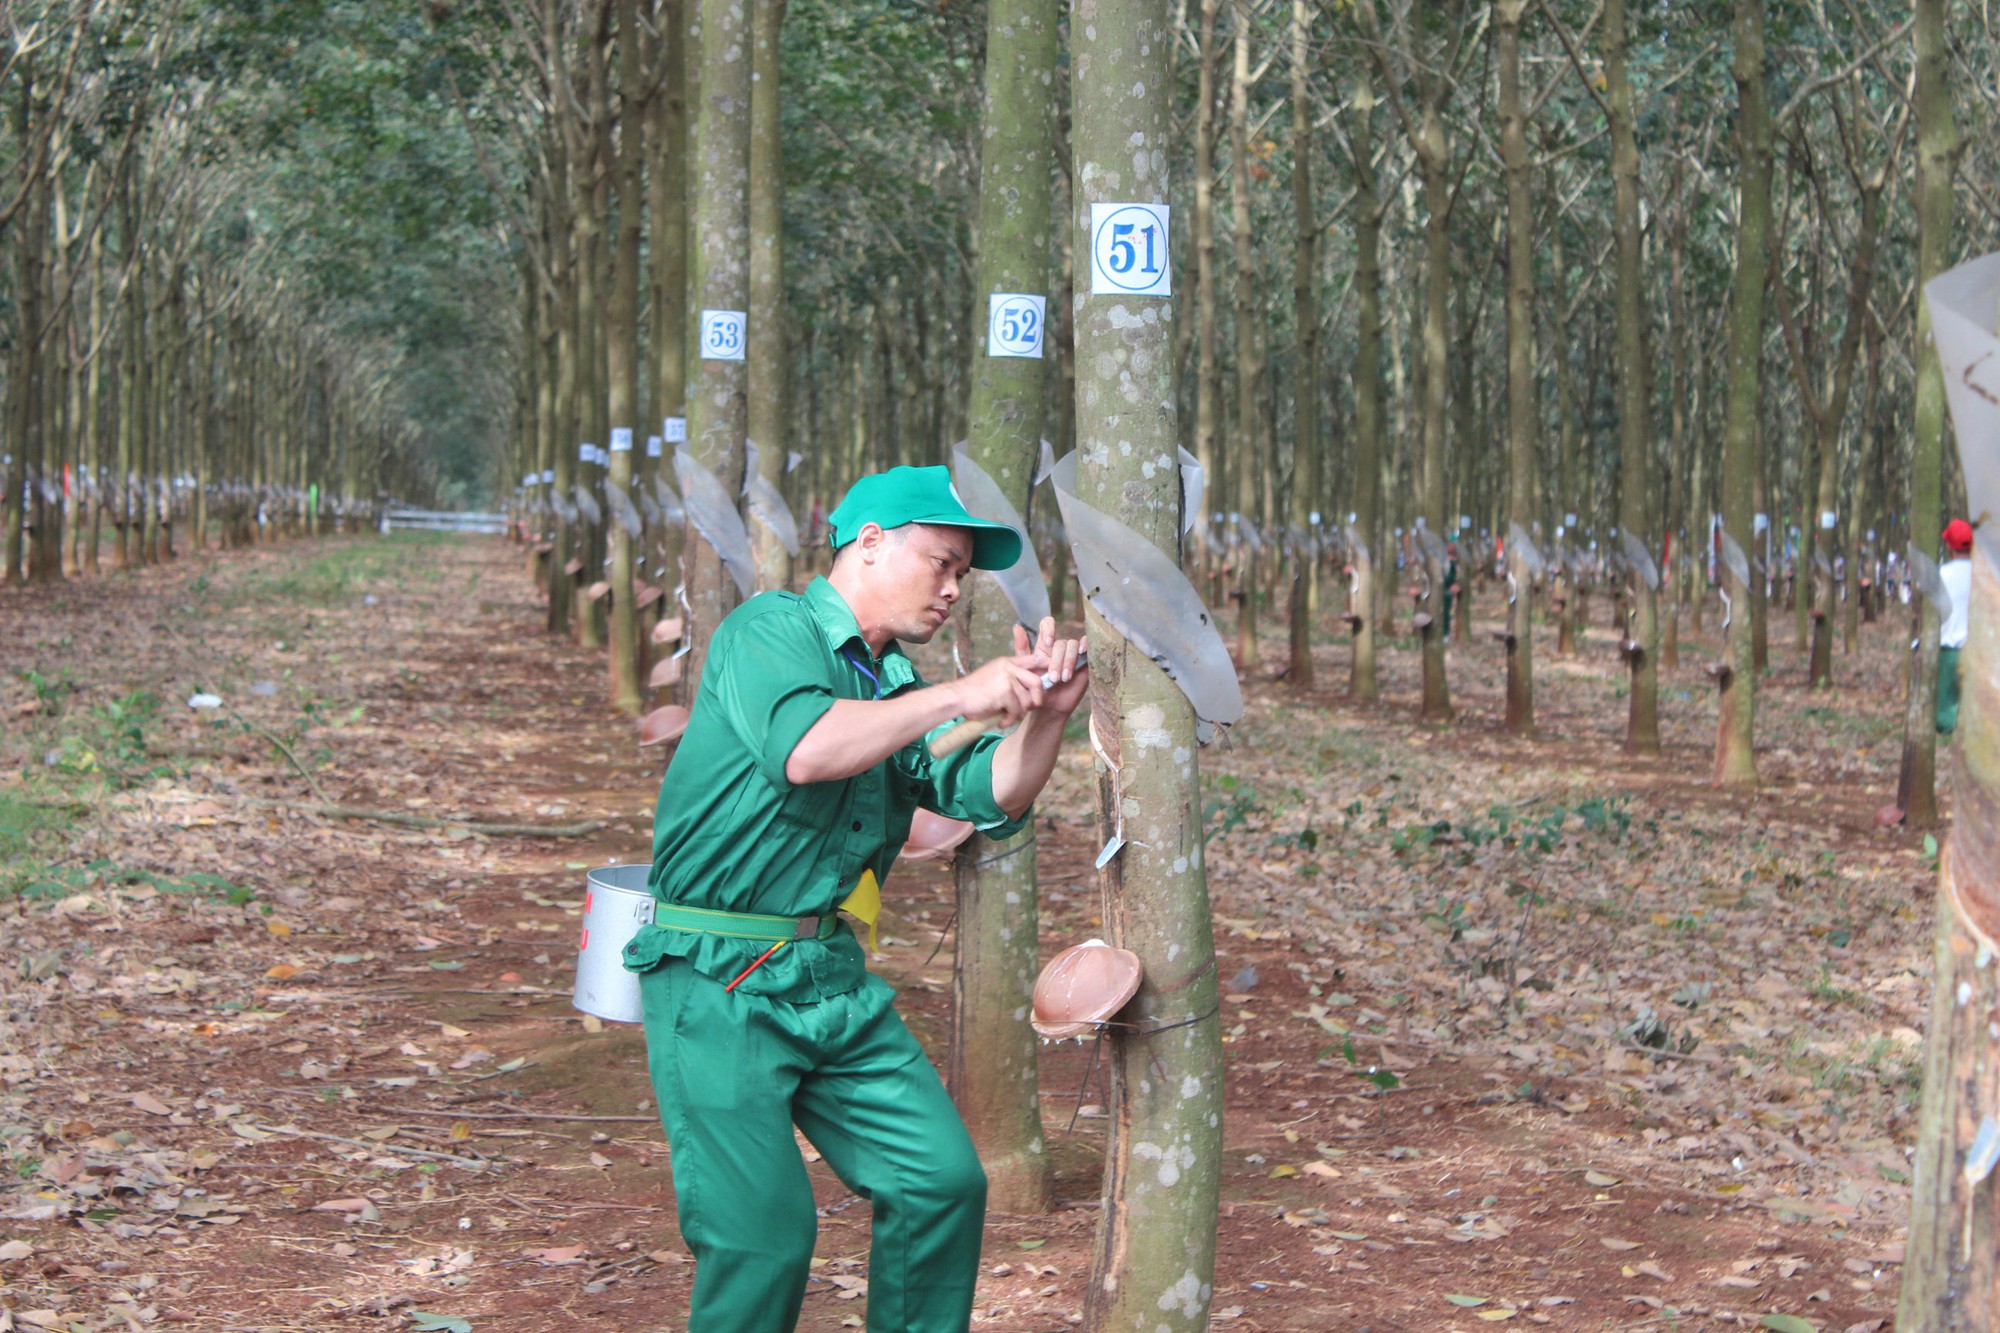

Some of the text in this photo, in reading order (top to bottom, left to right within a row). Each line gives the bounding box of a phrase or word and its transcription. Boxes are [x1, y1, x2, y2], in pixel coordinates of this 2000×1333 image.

[1109, 223, 1159, 273] 51
[710, 321, 738, 348] 53
[1002, 308, 1037, 342] 52
